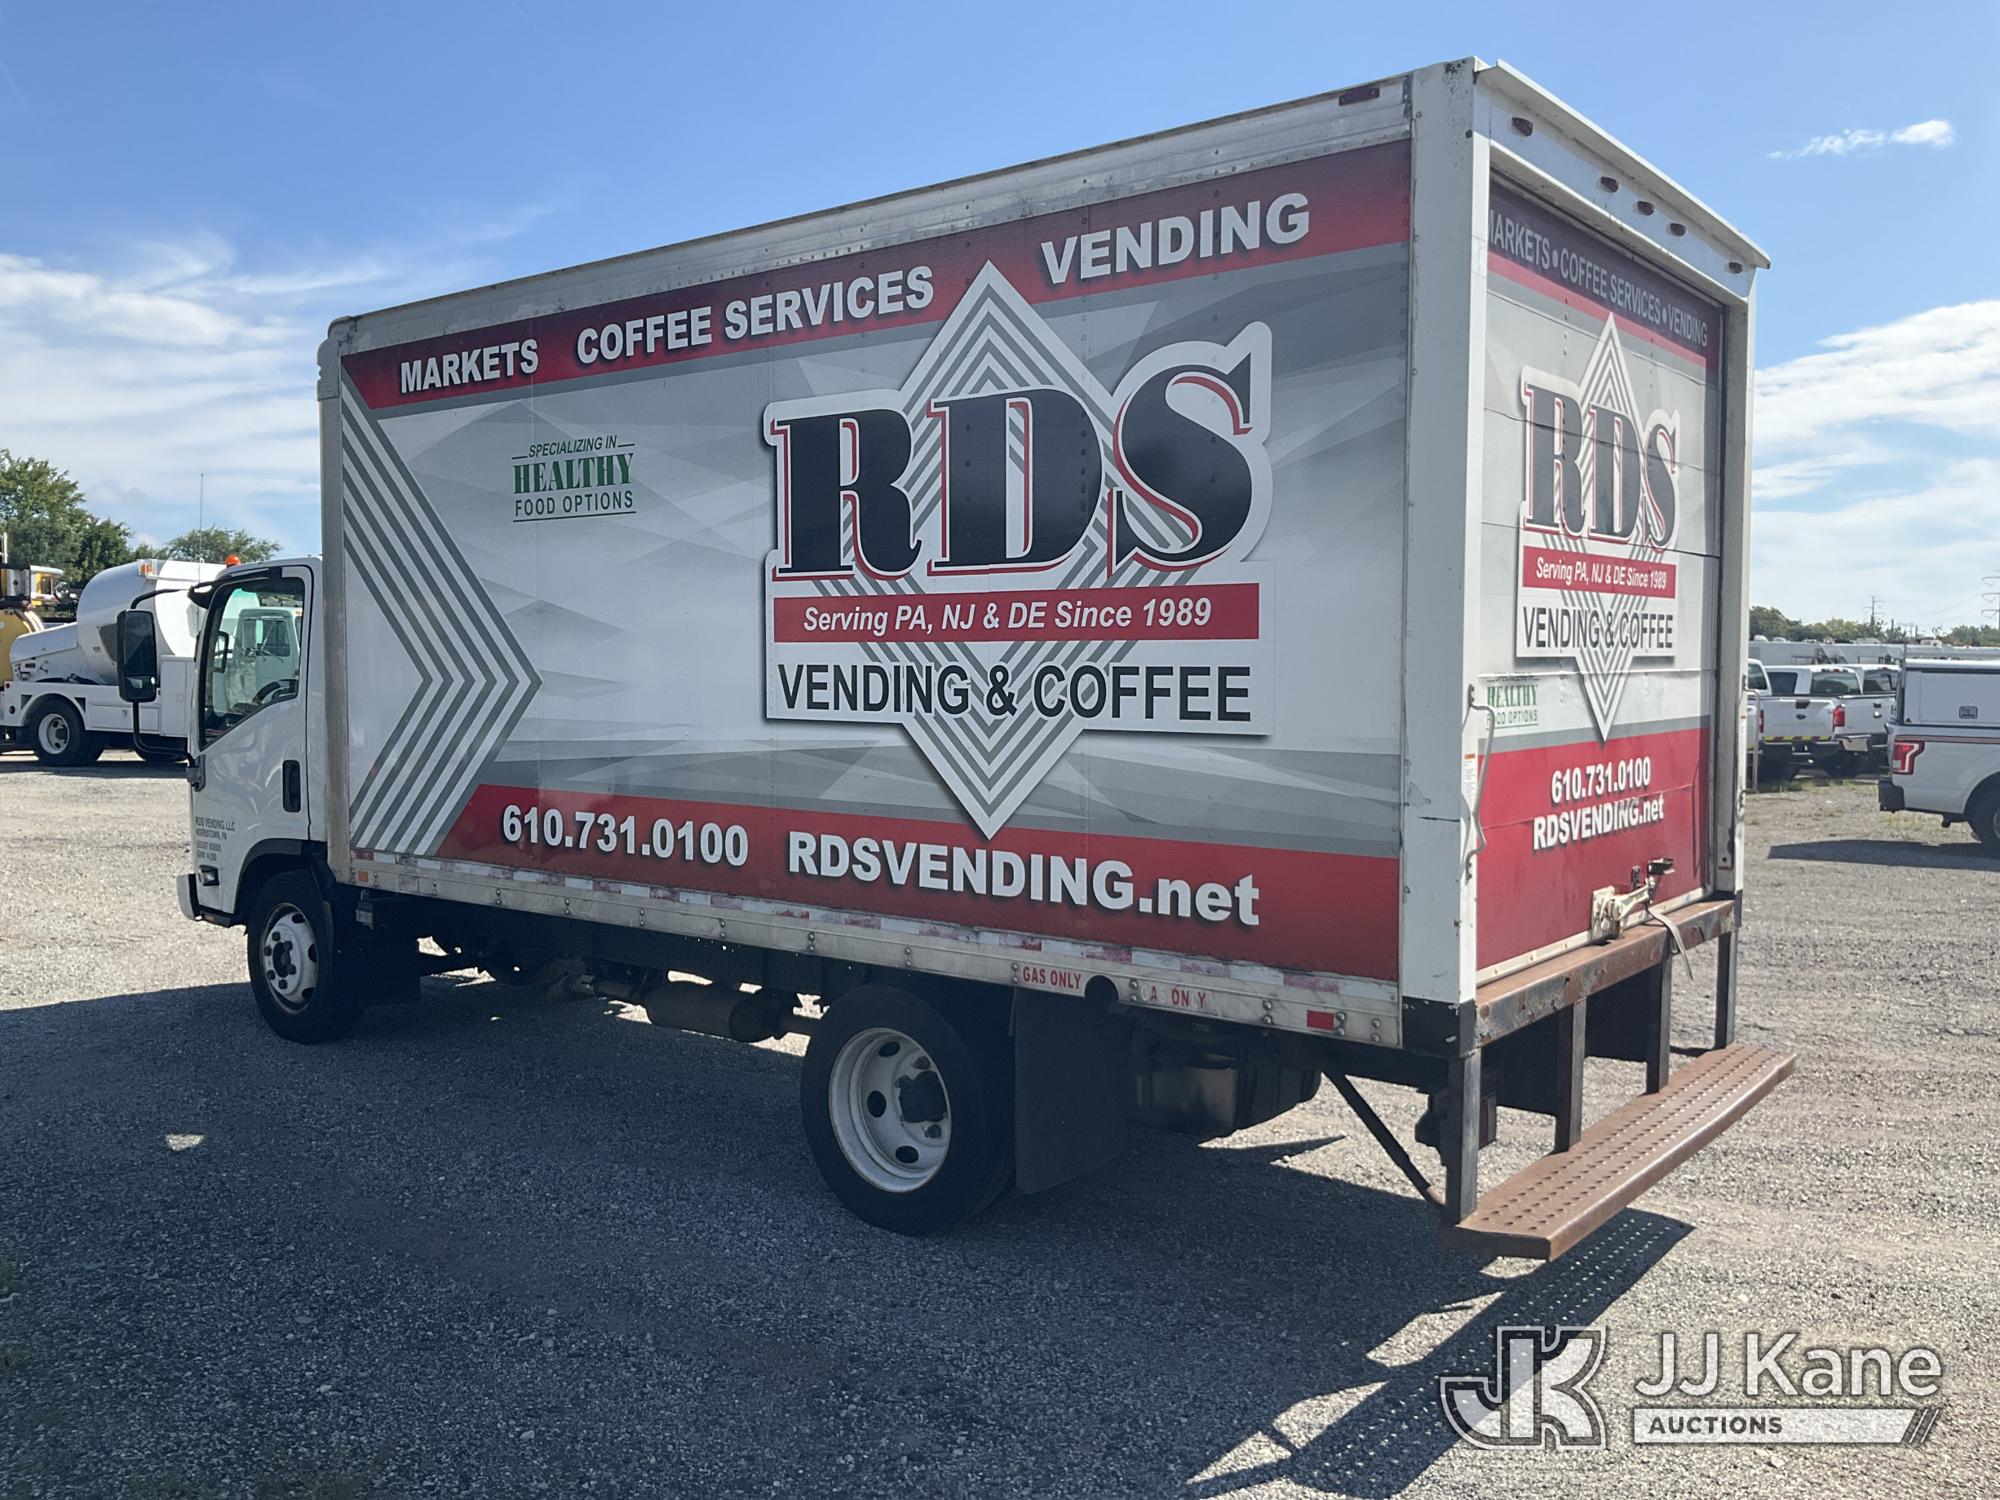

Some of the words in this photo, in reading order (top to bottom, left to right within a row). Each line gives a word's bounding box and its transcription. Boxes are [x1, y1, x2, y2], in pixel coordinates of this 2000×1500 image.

[1041, 193, 1309, 284] VENDING
[577, 306, 712, 364] COFFEE
[725, 266, 934, 340] SERVICES
[1560, 248, 1608, 298] COFFEE
[1610, 274, 1661, 325] SERVICES
[1668, 304, 1708, 347] VENDING
[401, 339, 538, 393] MARKETS
[529, 437, 602, 458] SPECIALIZING
[605, 435, 617, 449] IN
[770, 352, 1253, 582] RDS
[1523, 383, 1676, 553] RDS
[513, 453, 634, 494] HEALTHY
[515, 498, 555, 517] FOOD
[563, 490, 633, 513] OPTIONS
[1536, 557, 1572, 586] Serving
[1574, 562, 1588, 585] PA,
[1591, 564, 1603, 584] NJ
[1605, 566, 1612, 584] &
[1613, 566, 1626, 585] DE
[1626, 567, 1648, 588] Since
[1650, 570, 1667, 589] 1989
[803, 607, 888, 637] Serving
[895, 605, 933, 635] PA,
[942, 603, 976, 630] NJ
[983, 602, 1000, 629] &
[1008, 602, 1047, 628] DE
[1054, 600, 1132, 627] Since
[1143, 597, 1211, 626] 1989
[1523, 606, 1600, 648] VENDING
[1605, 610, 1614, 648] &
[1619, 610, 1673, 649] COFFEE
[778, 664, 970, 716] VENDING
[986, 664, 1017, 716] &
[1033, 665, 1251, 721] COFFEE
[1487, 684, 1537, 707] HEALTHY
[1487, 711, 1505, 725] FOD
[1509, 709, 1537, 723] OPTIONS
[1551, 756, 1650, 803] 610.731.0100
[502, 804, 748, 867] 610.731.0100
[1533, 792, 1665, 850] RDSVENDING.net
[788, 831, 1260, 925] RDSVENDING.net
[1023, 966, 1045, 985] GAS
[1050, 970, 1082, 990] ONLY
